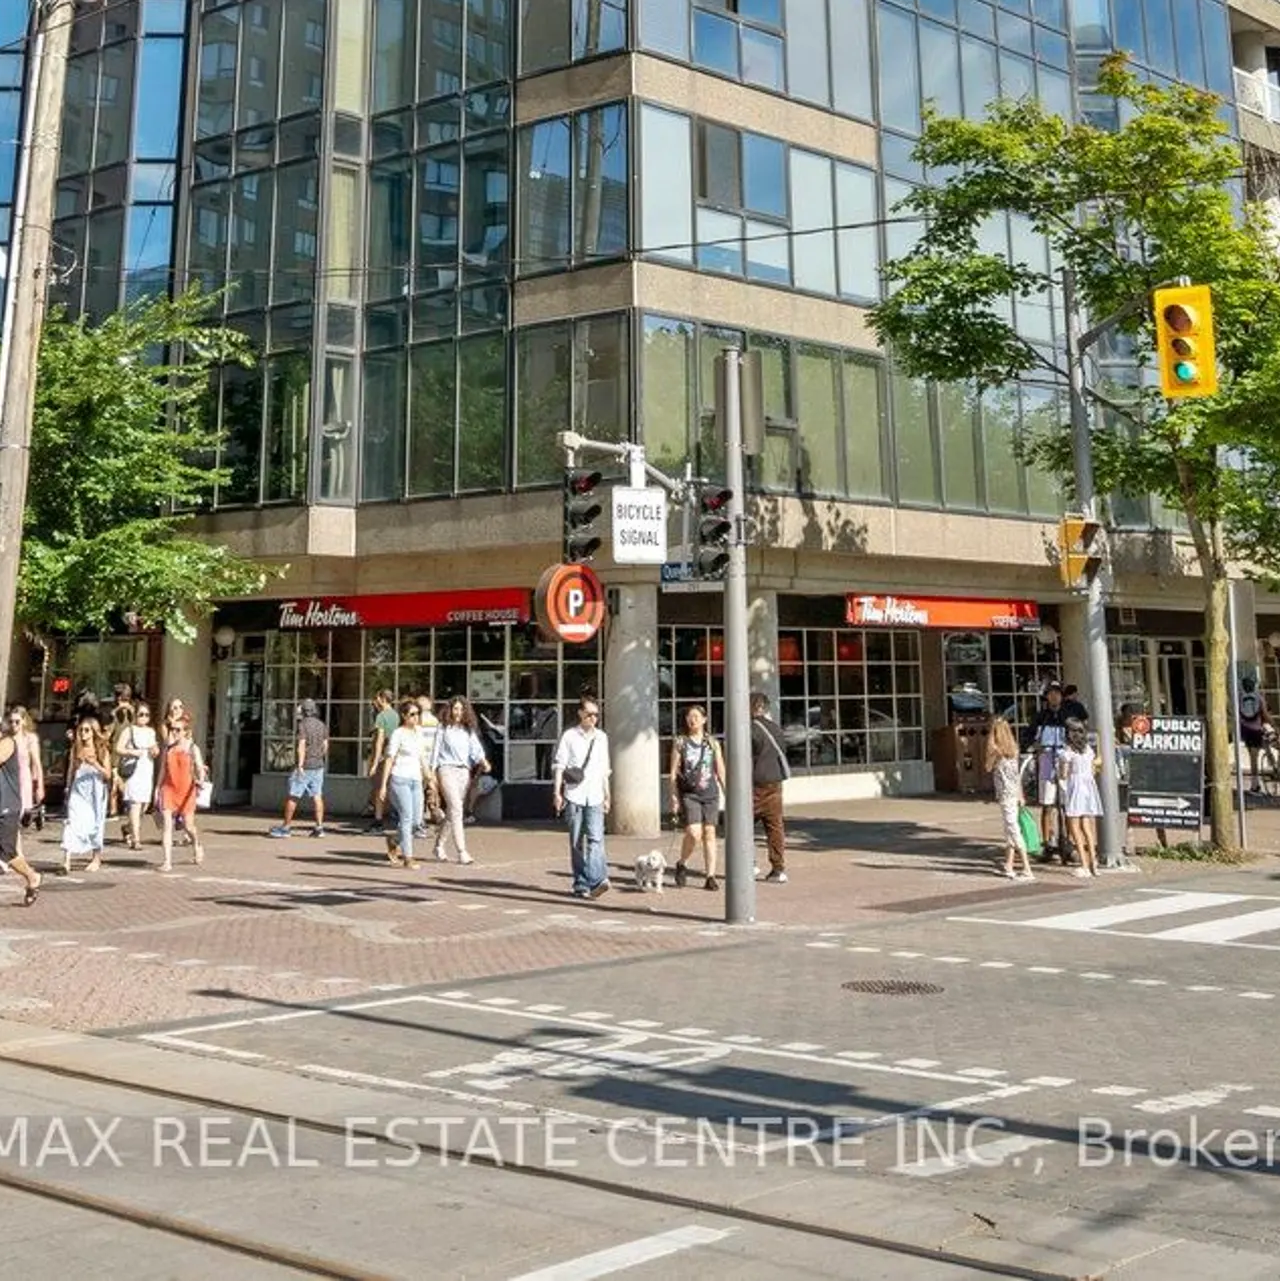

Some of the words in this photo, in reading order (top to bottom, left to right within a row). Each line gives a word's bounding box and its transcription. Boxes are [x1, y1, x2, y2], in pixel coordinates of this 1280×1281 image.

[616, 504, 662, 520] BICYCLE
[620, 530, 660, 546] SIGNAL
[569, 589, 584, 618] P
[860, 596, 883, 623] Tim
[884, 596, 928, 624] Hortons
[280, 602, 303, 628] Tim
[305, 601, 357, 627] Hortons
[1153, 719, 1201, 731] PUBLIC
[1133, 733, 1201, 750] PARKING
